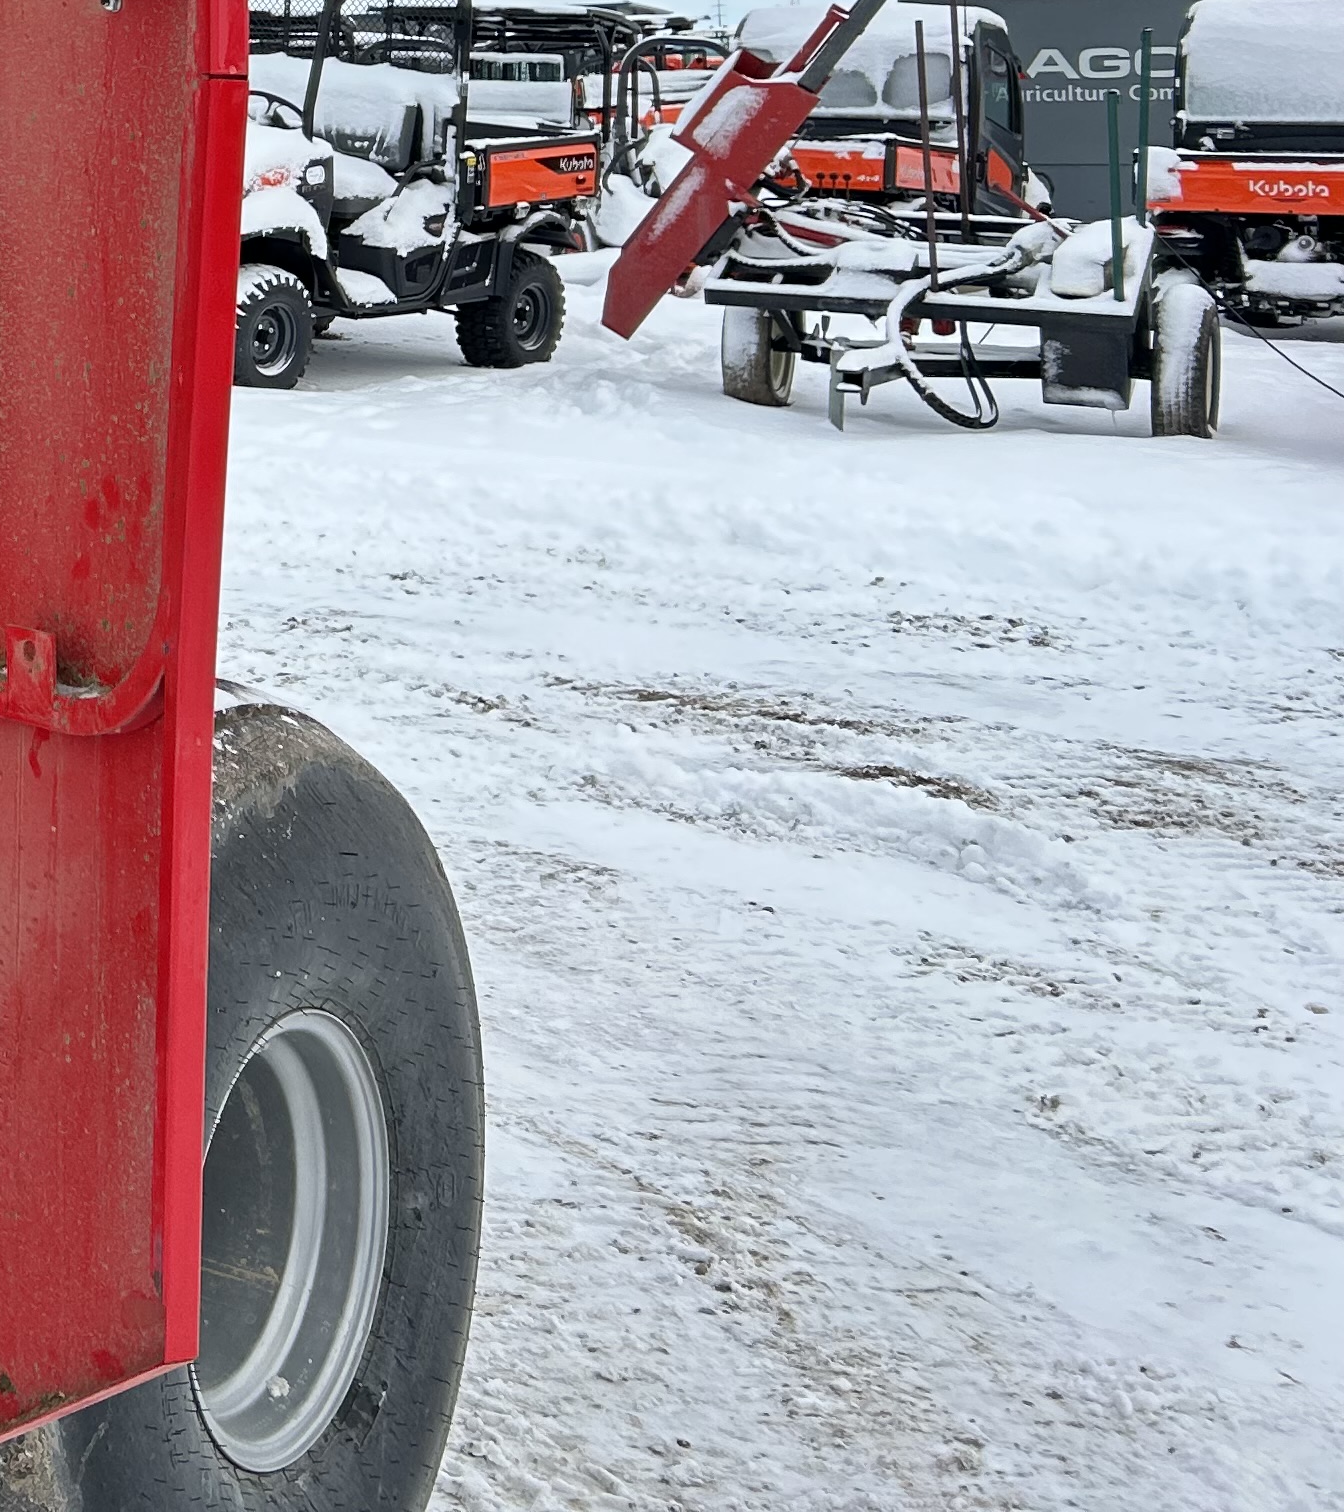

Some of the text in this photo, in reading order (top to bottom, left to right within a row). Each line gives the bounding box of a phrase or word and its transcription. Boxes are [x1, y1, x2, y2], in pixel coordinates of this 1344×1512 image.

[1026, 46, 1178, 79] AGC
[995, 85, 1120, 103] Aricultur
[559, 155, 594, 172] Kubota
[1248, 179, 1330, 197] Kubota
